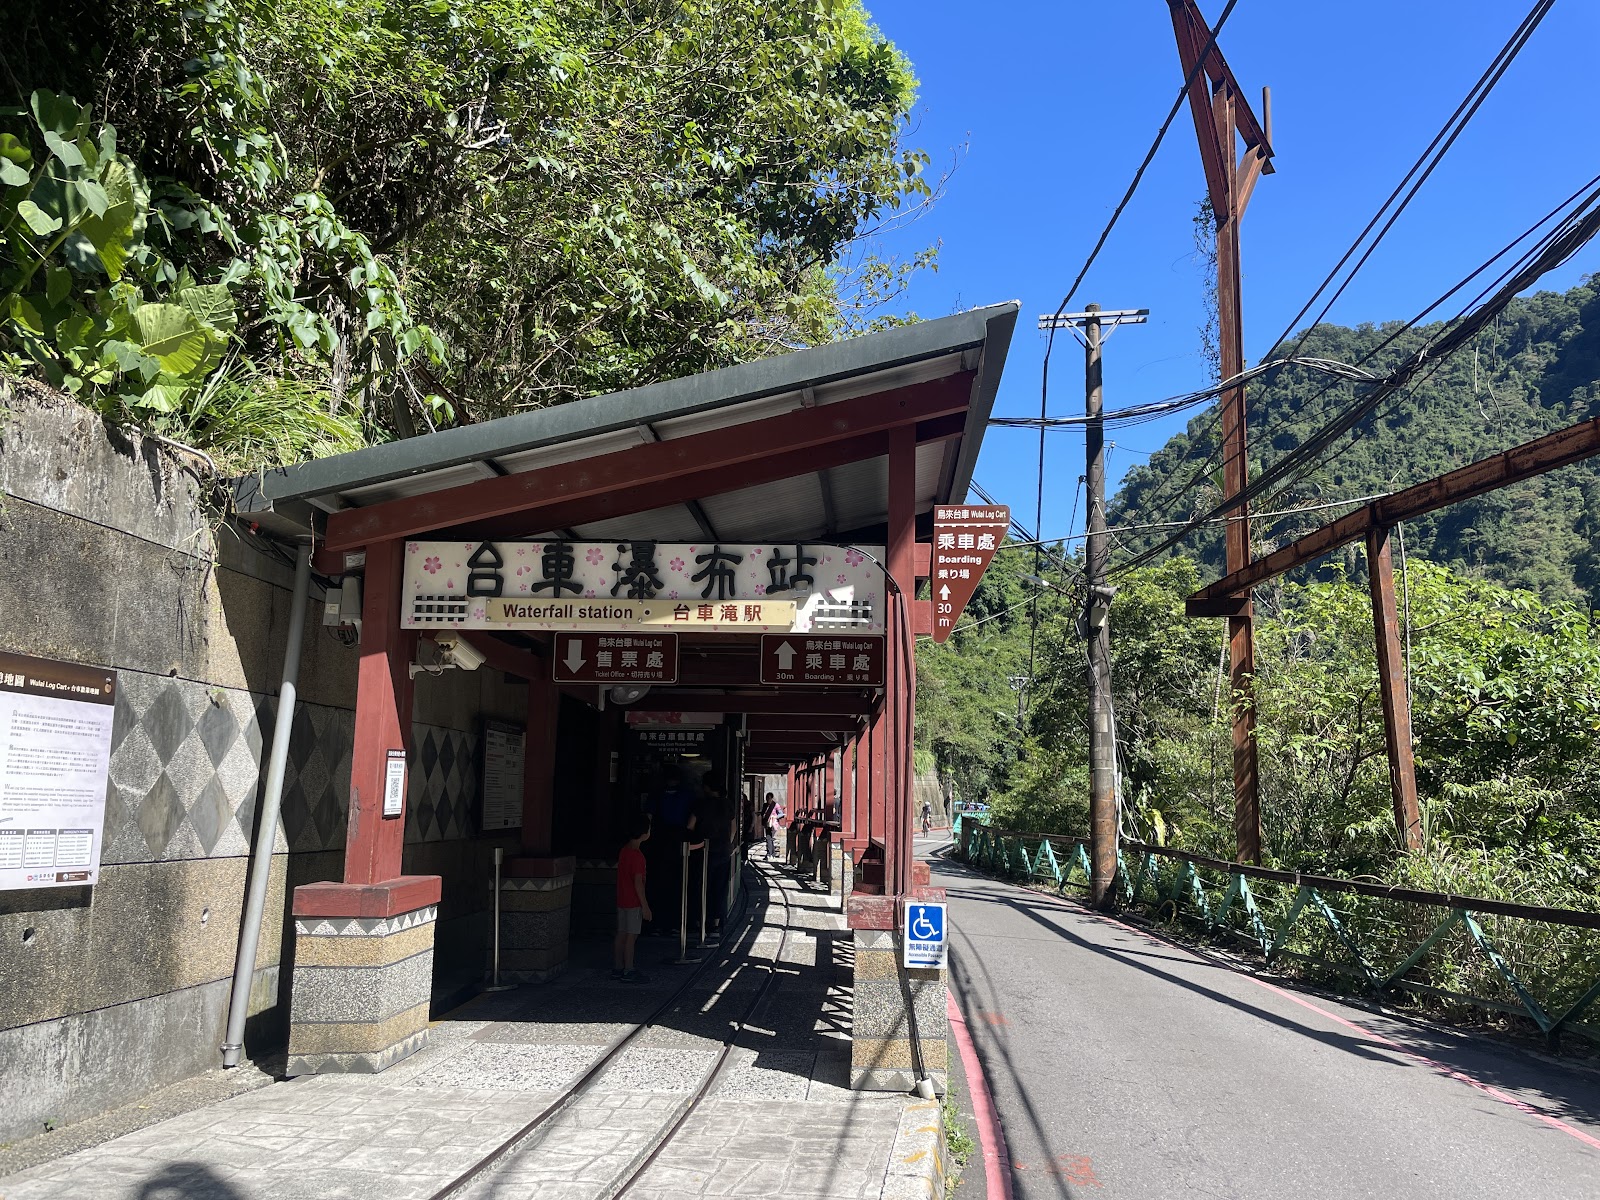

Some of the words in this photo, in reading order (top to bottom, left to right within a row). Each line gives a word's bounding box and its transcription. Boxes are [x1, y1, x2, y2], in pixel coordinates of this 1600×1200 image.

[971, 510, 984, 518] Wulai
[985, 510, 994, 519] Log
[995, 510, 1006, 518] Cart
[938, 533, 995, 551] 乘車處
[938, 556, 982, 565] Boarding
[466, 540, 818, 599] 台車瀑布站
[938, 569, 970, 579] 乗り場
[502, 603, 573, 619] Waterfall
[578, 604, 633, 620] station
[672, 603, 762, 622] 台車滝駅
[938, 603, 952, 614] 30
[939, 618, 950, 627] m
[645, 640, 654, 649] Log
[854, 642, 863, 651] Log
[596, 651, 664, 668] 售票處
[806, 653, 870, 671] 乘車處
[595, 670, 610, 678] Ticket
[610, 670, 625, 678] Office
[805, 673, 835, 682] Boarding
[30, 679, 45, 688] Wulai
[46, 681, 56, 690] Log
[57, 683, 68, 691] Cart
